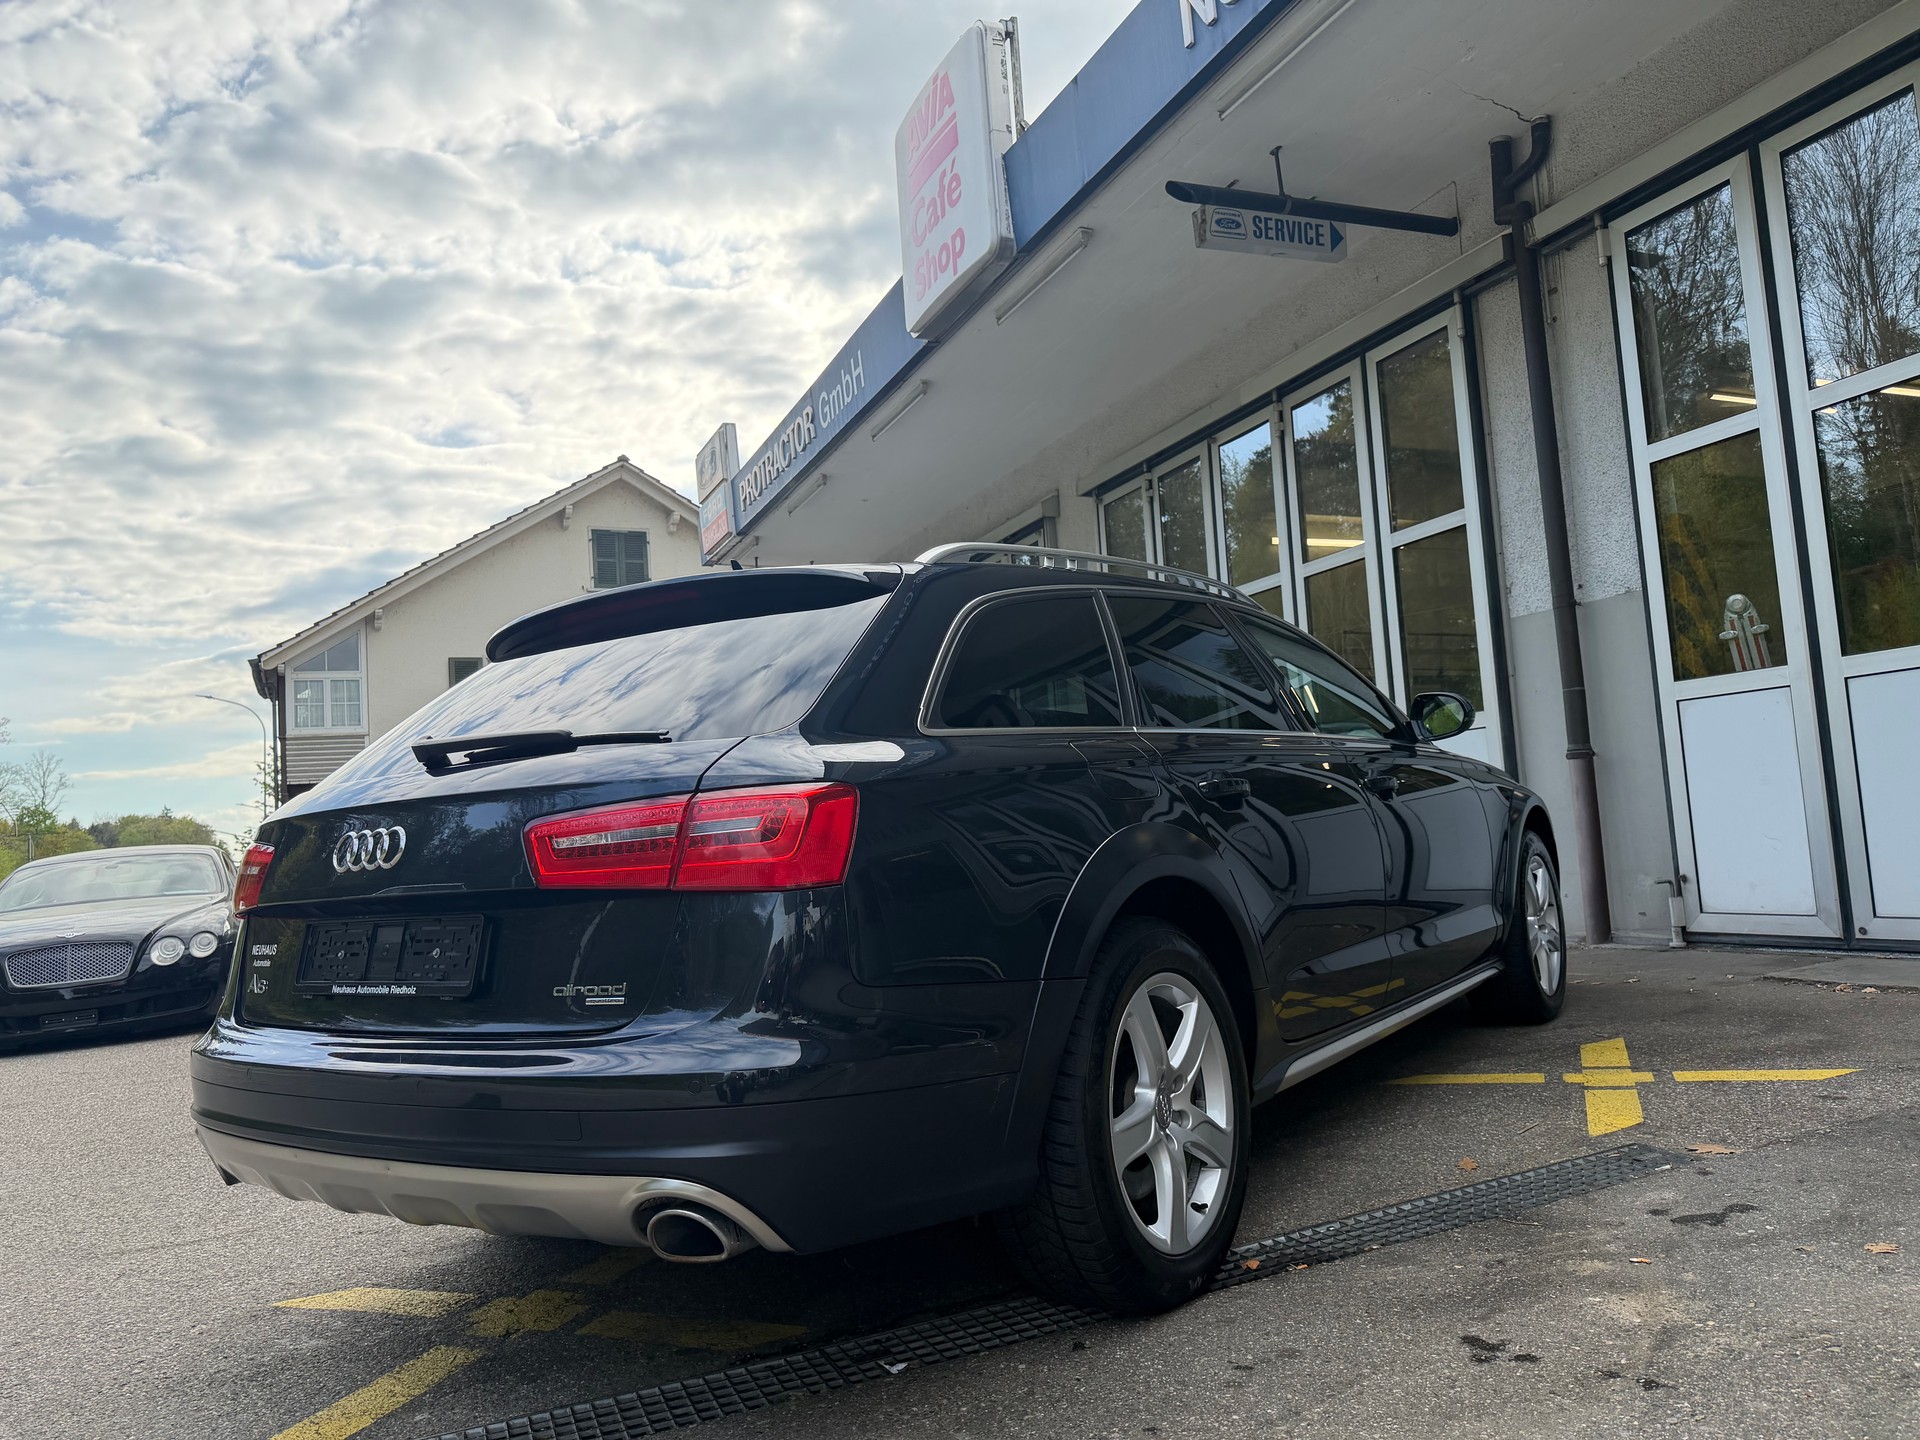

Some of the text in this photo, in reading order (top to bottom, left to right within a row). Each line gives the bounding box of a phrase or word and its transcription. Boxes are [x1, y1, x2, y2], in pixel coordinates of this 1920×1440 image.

[912, 156, 962, 248] Café
[1252, 215, 1325, 247] SERVICE
[914, 227, 966, 302] Shop
[738, 350, 866, 513] PROTRACTOR GmbH
[252, 944, 277, 956] NEUHAUS
[332, 985, 417, 995] Neuhaus Automobile Riedholz
[552, 982, 627, 997] allroad
